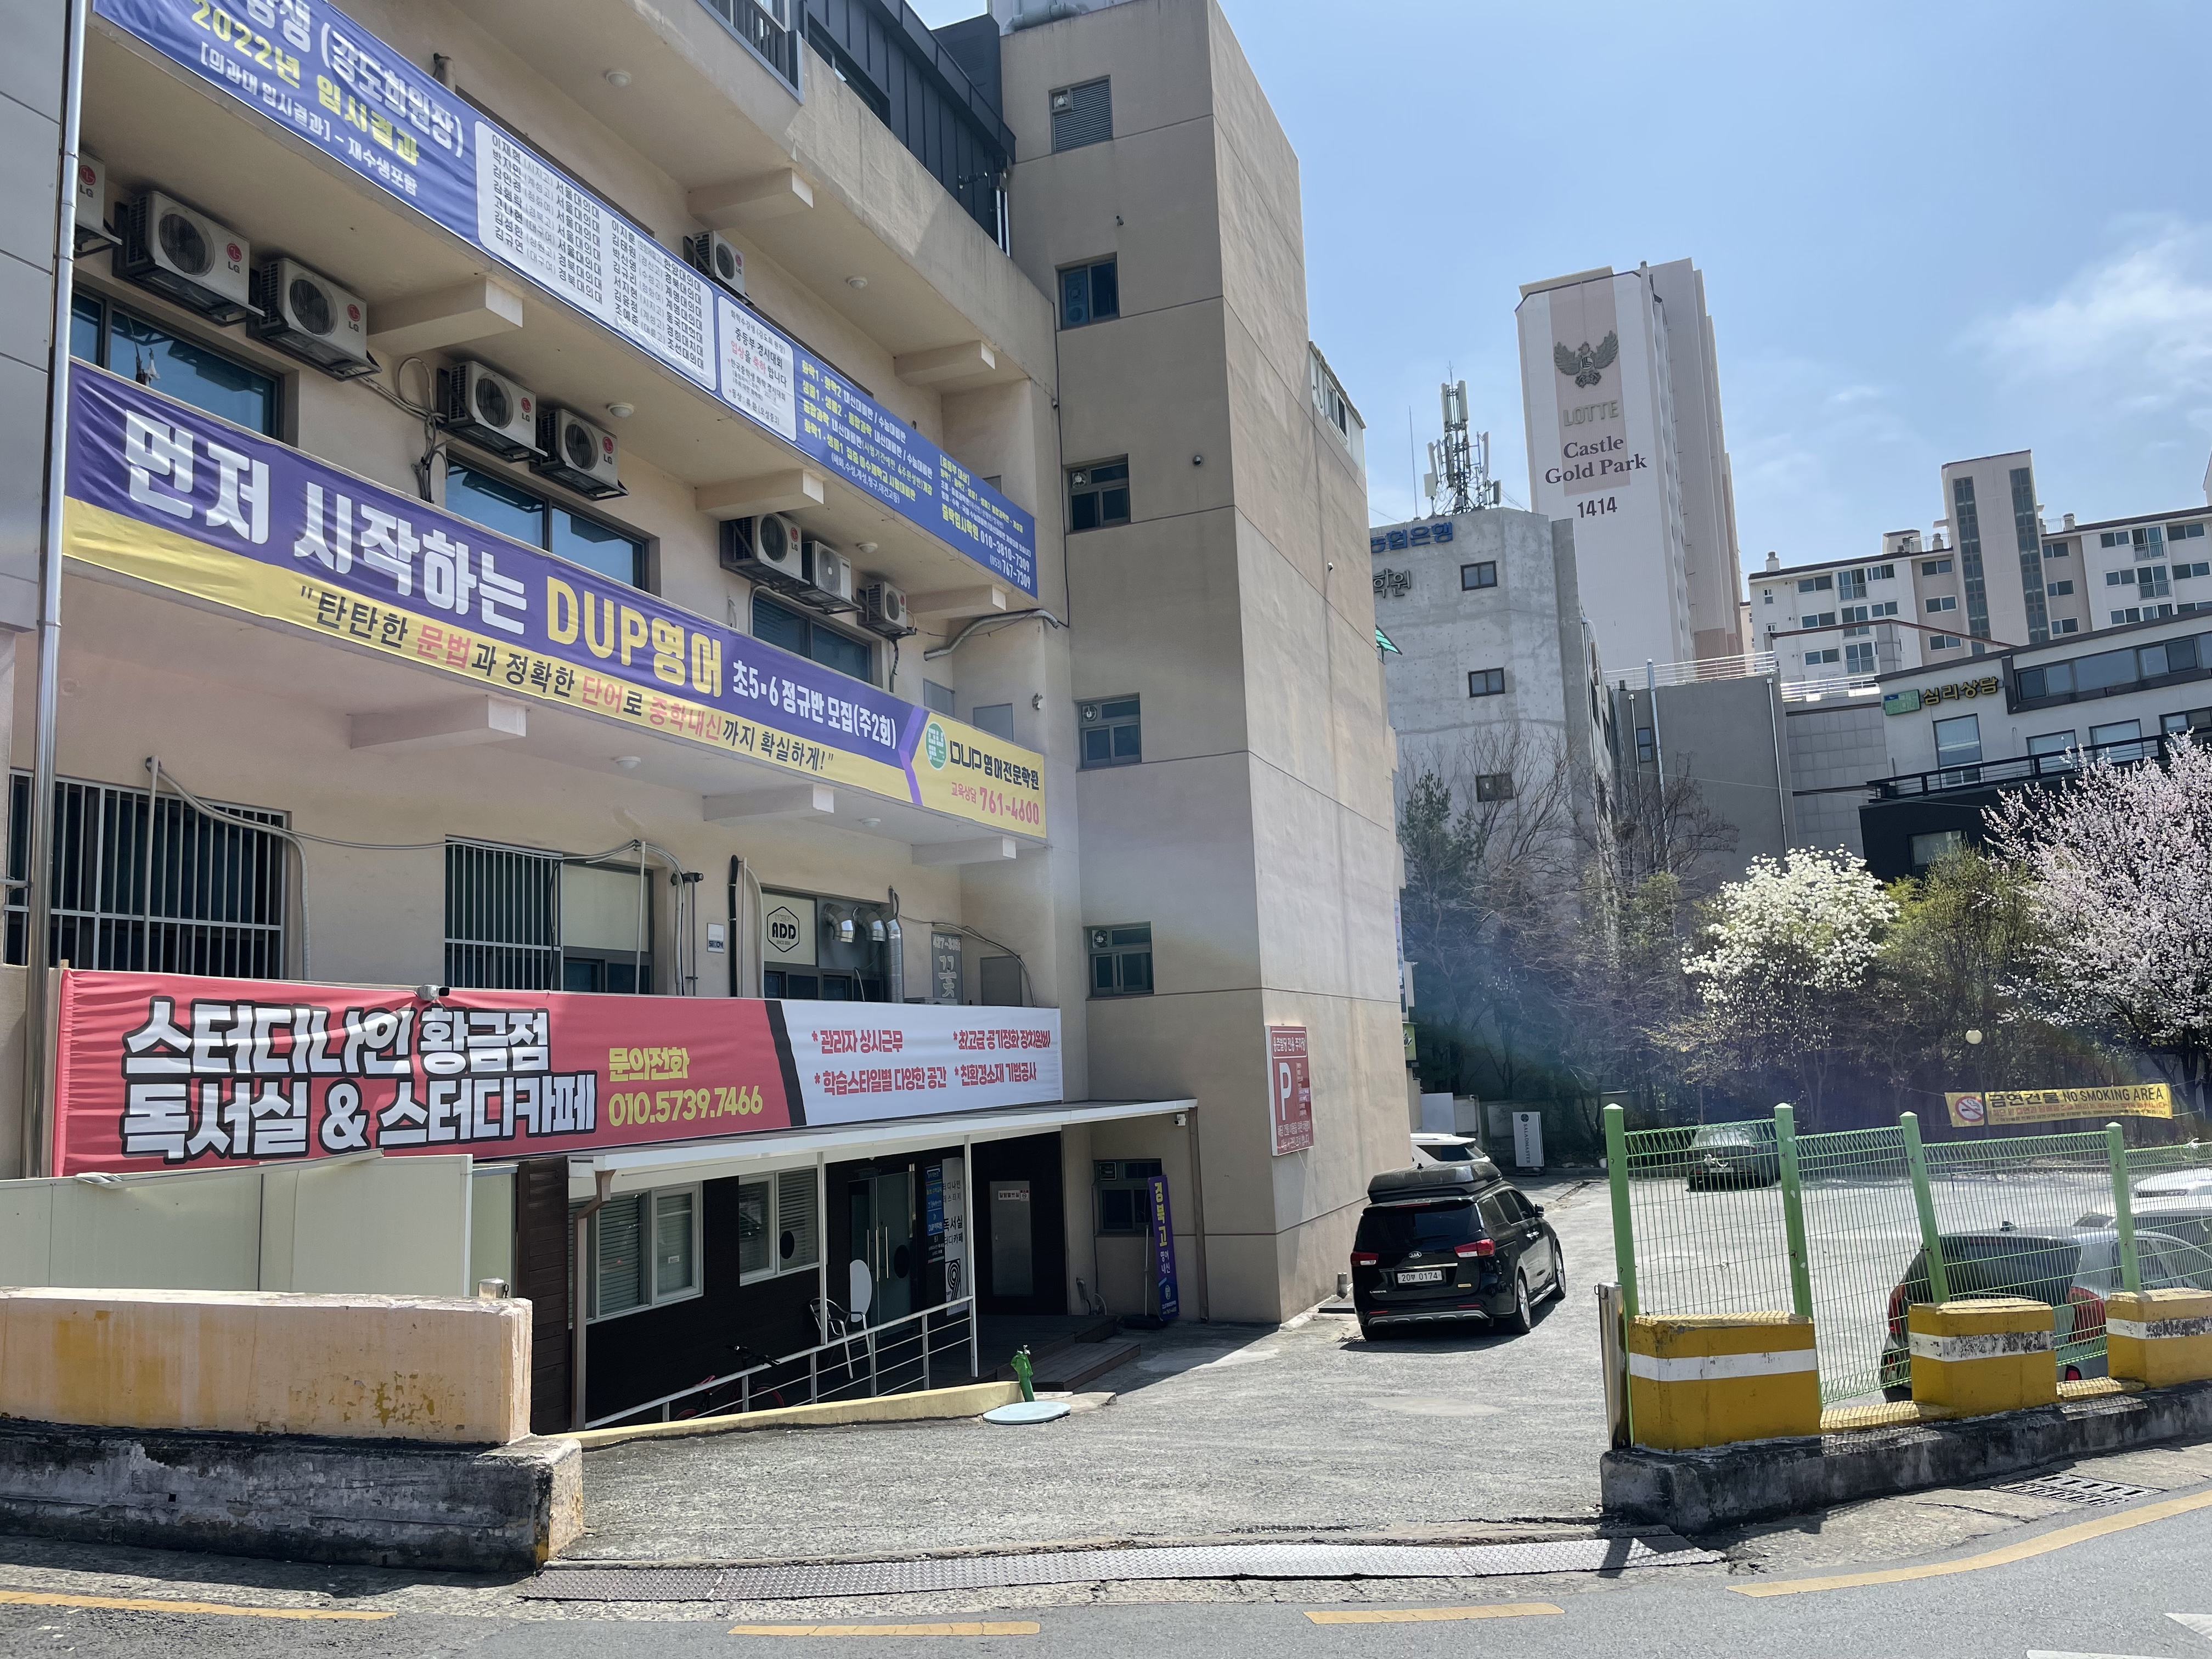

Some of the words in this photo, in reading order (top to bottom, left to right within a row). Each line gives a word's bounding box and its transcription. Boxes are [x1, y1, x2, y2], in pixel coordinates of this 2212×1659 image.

[192, 0, 300, 89] 2022년
[317, 75, 419, 166] 입시결과
[348, 137, 417, 196] 재수생포함
[80, 184, 93, 198] LG
[227, 260, 240, 274] LG
[348, 320, 359, 333] LG
[735, 326, 755, 351] 중등부
[757, 342, 782, 370] 경시대회
[521, 412, 531, 423] LG
[1563, 400, 1620, 426] LOTTE
[603, 454, 613, 465] LG
[1564, 436, 1624, 459] Castle
[1545, 462, 1594, 485] Gold
[1600, 454, 1647, 476] Park
[1577, 496, 1617, 518] 1414
[791, 543, 798, 551] LG
[980, 529, 1030, 574] 010-3810-7309
[125, 410, 269, 544] 먼저
[294, 481, 527, 635] 시작하는
[547, 576, 722, 698] DUP영어
[782, 679, 825, 724] 정규반
[1002, 558, 1031, 590] 767-7309
[416, 624, 496, 676] 문법과
[506, 652, 575, 698] 정확한
[582, 675, 644, 717] 단어로
[649, 696, 755, 752] 중학내신까지
[1923, 676, 1998, 706] 심리상담
[952, 782, 977, 804] 교육상담
[980, 786, 1040, 825] 761-4600
[772, 922, 796, 939] ADD
[126, 1001, 414, 1076] 스터디나인
[420, 1007, 549, 1074] 황금점
[860, 1030, 904, 1053] 상시근무
[986, 1029, 1019, 1049] 공기정화
[1020, 1030, 1050, 1049] 장치완비
[608, 1047, 690, 1081] 문의전화
[1006, 1062, 1036, 1082] 기법공사
[895, 1067, 926, 1091] 다양한
[928, 1066, 946, 1090] 공간
[1279, 1062, 1292, 1121] P
[1989, 1092, 2059, 1108] 금연건물
[2063, 1091, 2078, 1102] NO
[2080, 1088, 2130, 1101] SMOKING
[2134, 1087, 2164, 1101] AREA
[123, 1081, 307, 1159] 독서실
[320, 1081, 369, 1150] &
[379, 1074, 597, 1146] 스터디카페
[608, 1086, 763, 1127] 010.5739.7466
[1160, 1250, 1169, 1262] 영어
[1161, 1263, 1171, 1274] 내신
[1419, 1272, 1438, 1280] 0174
